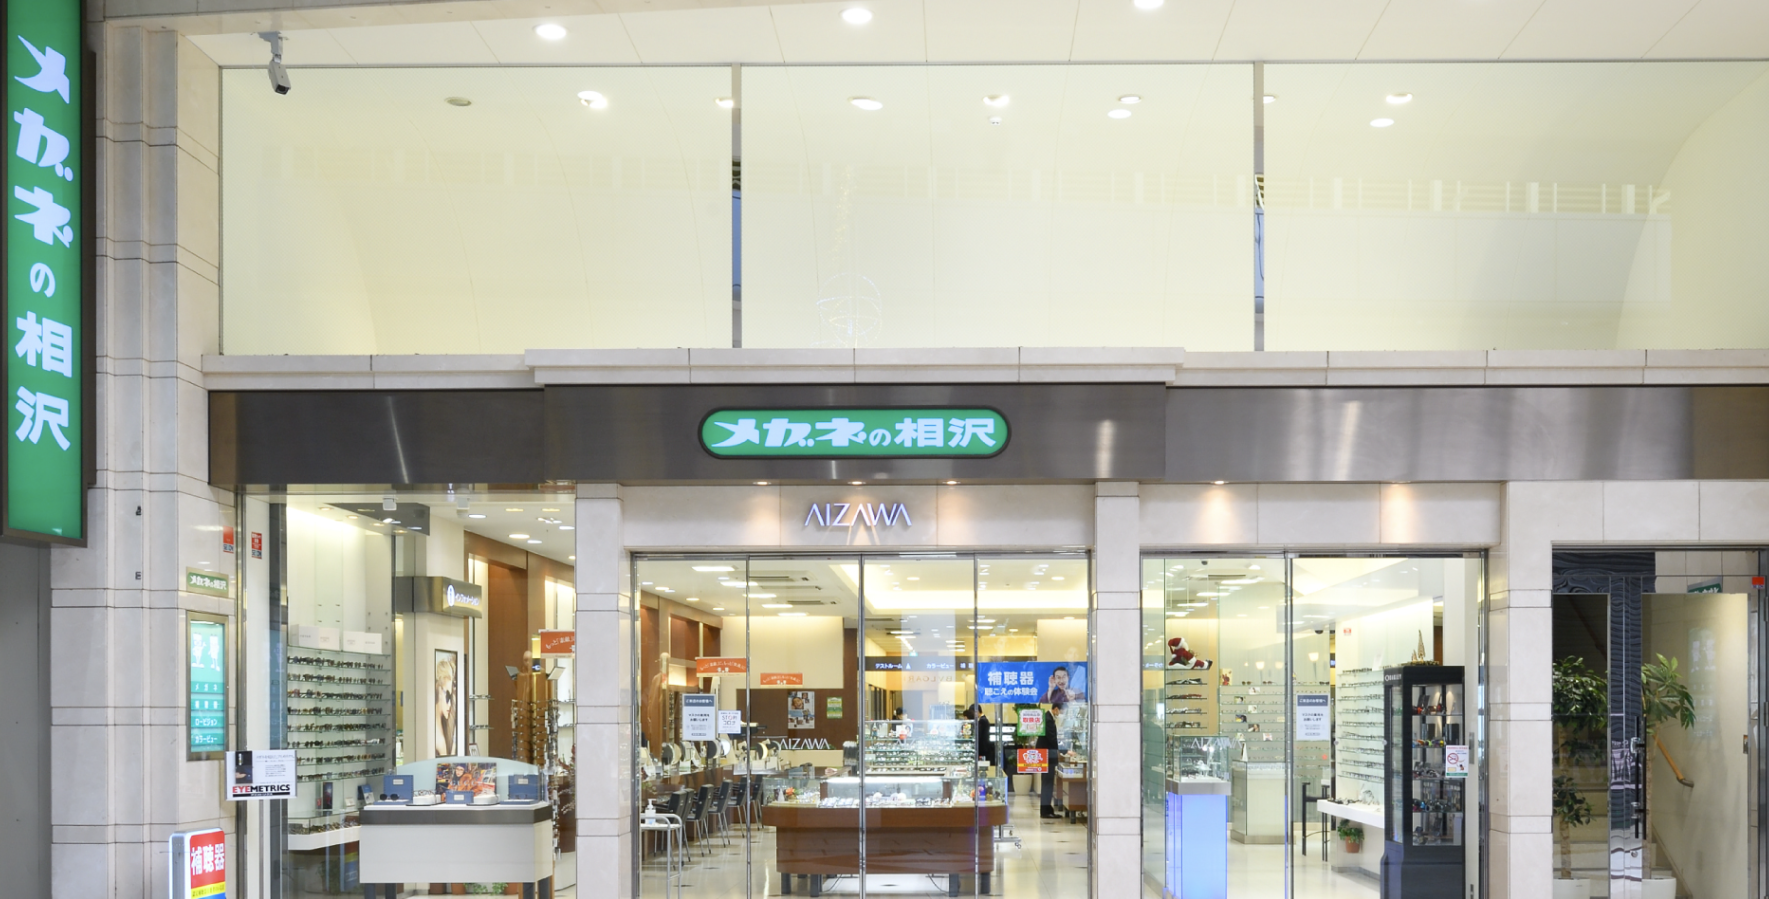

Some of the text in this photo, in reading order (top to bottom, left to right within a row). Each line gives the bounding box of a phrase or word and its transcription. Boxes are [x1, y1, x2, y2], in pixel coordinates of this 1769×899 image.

[14, 34, 74, 452] メガネの相沢
[711, 417, 997, 448] メガネの相沢
[804, 502, 912, 526] AIZAWA
[987, 671, 1034, 686] 補聴器
[984, 687, 1038, 696] 聴こえの体験会
[780, 738, 831, 750] AIZAWA
[232, 784, 291, 793] EYEMETRICS
[191, 843, 225, 876] 補聴器
